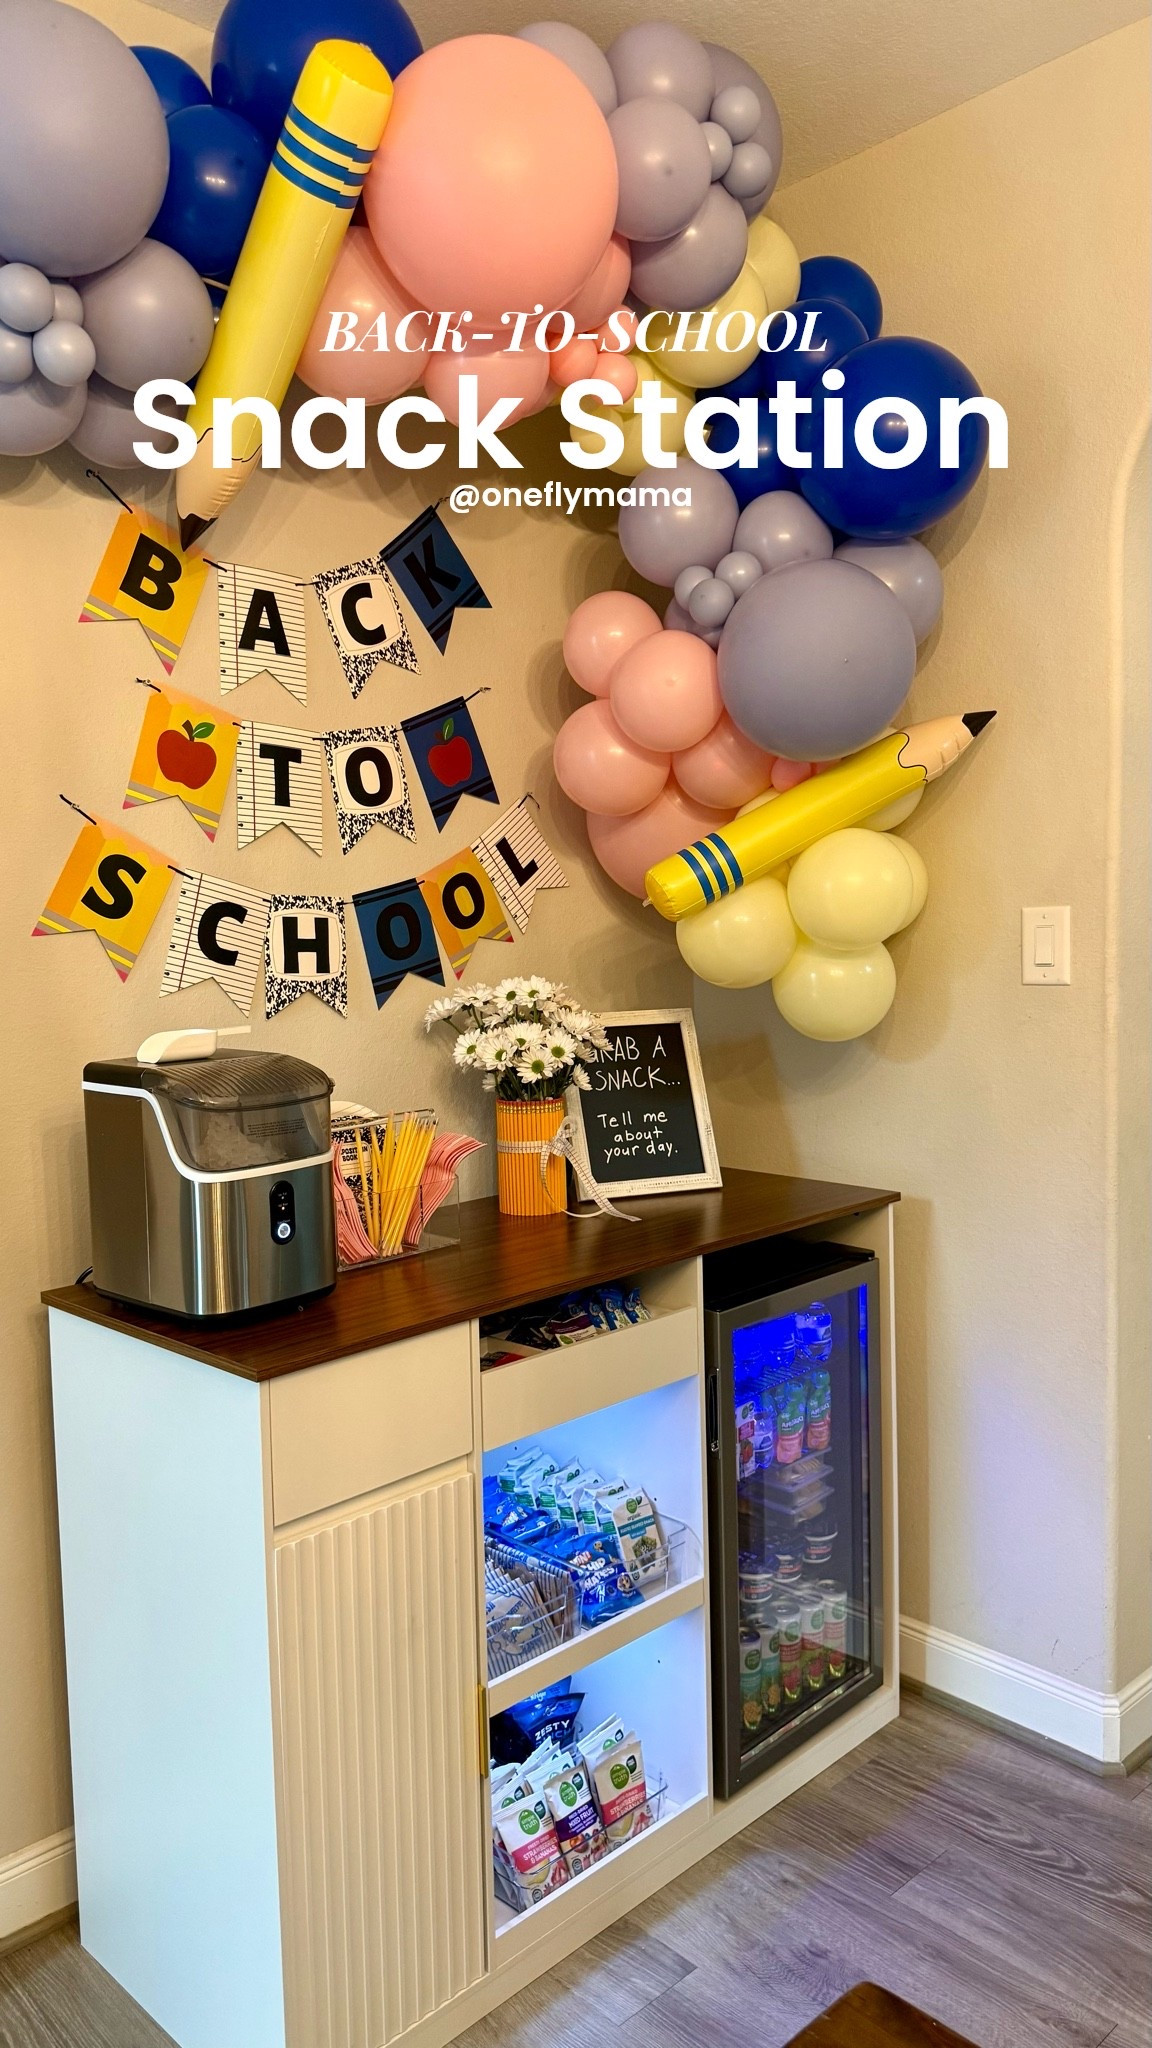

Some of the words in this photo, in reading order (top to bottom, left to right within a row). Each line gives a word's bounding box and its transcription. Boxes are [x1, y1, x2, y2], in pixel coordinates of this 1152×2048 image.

[118, 532, 463, 658] BACK
[259, 743, 394, 807] TO
[80, 836, 540, 974] SCHOOL
[591, 1036, 640, 1064] RAB
[652, 1035, 667, 1059] A
[595, 1066, 681, 1091] SNACK...
[597, 1110, 633, 1129] Tell
[643, 1110, 668, 1123] me
[614, 1126, 663, 1143] about
[604, 1144, 640, 1164] your
[646, 1140, 678, 1157] day.
[534, 1719, 570, 1741] ZESTY
[523, 1818, 538, 1830] truth
[580, 1807, 594, 1820] FRUIT
